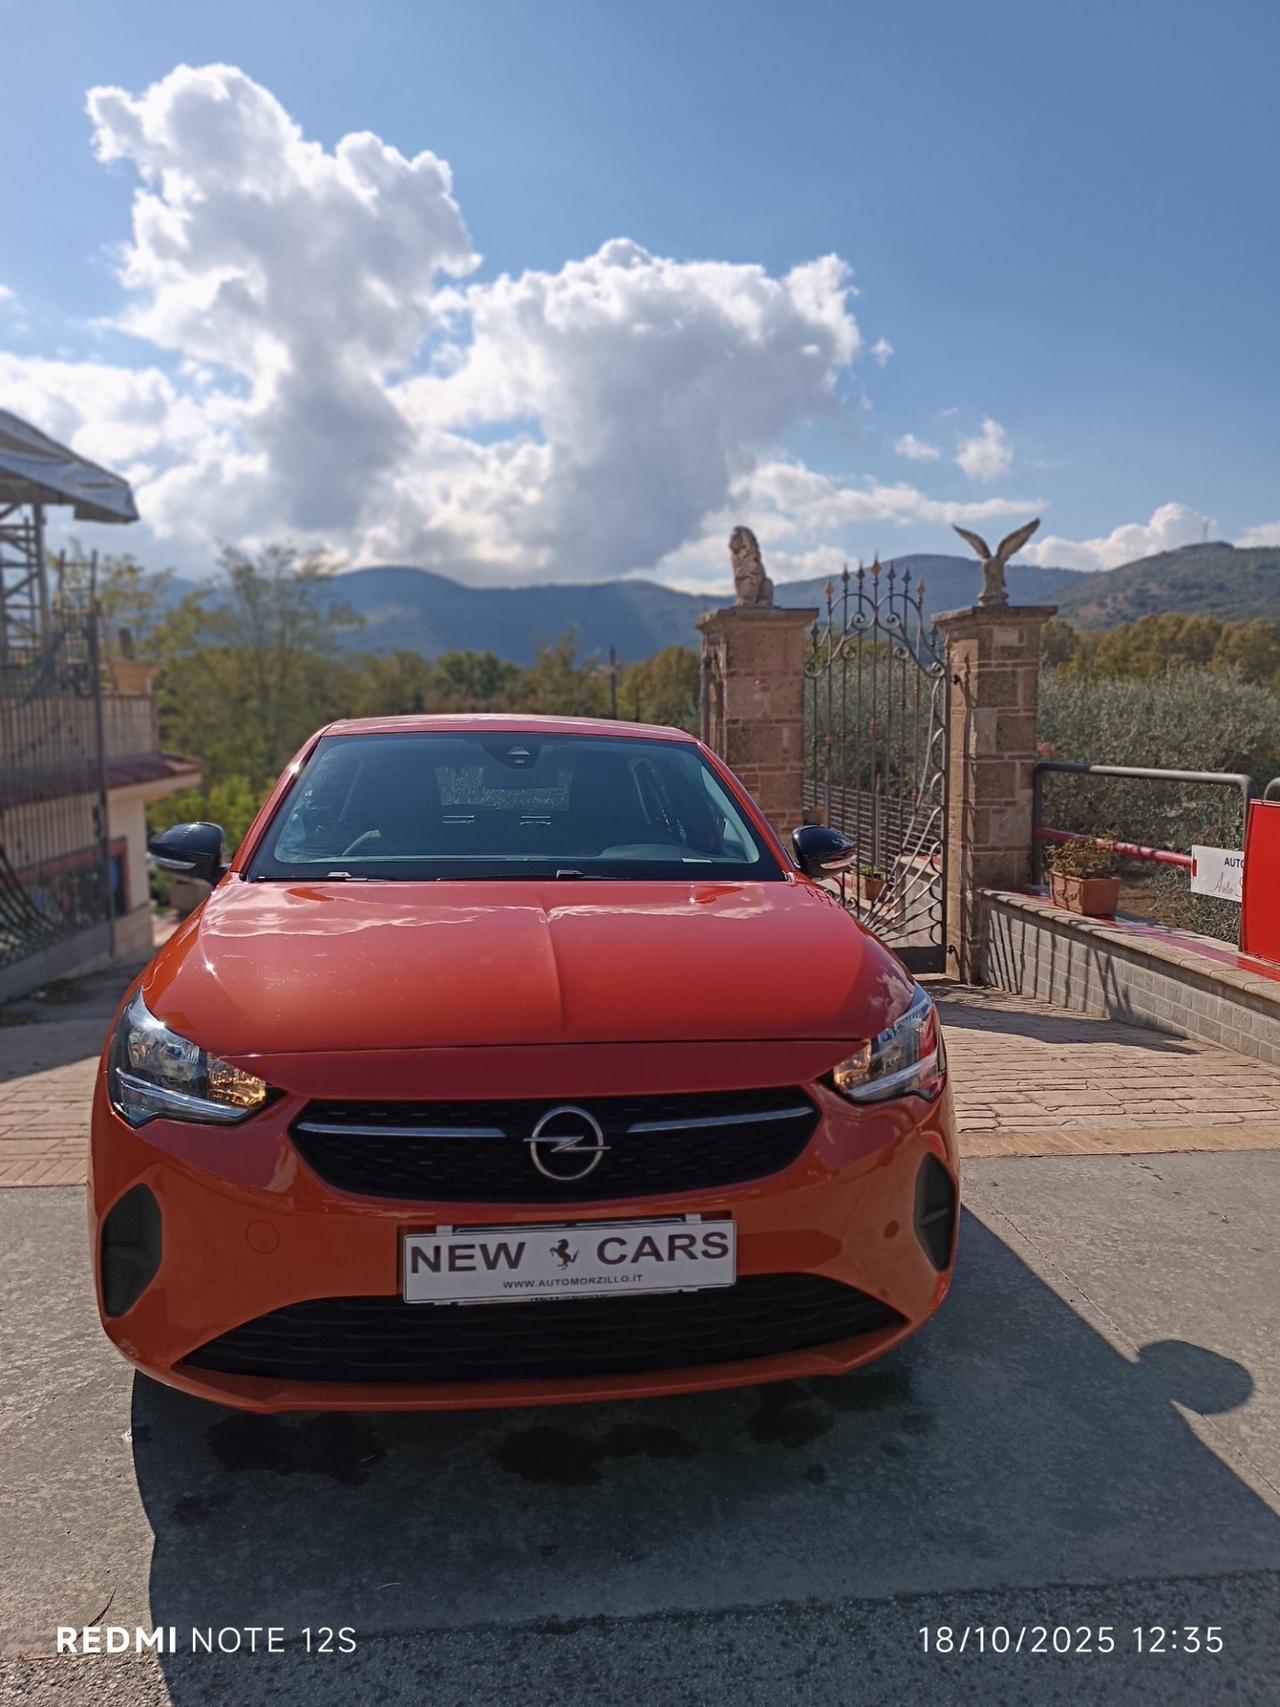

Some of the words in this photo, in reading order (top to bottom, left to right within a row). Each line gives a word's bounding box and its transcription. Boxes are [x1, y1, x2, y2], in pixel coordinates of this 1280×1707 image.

[410, 1241, 526, 1274] NEW
[596, 1231, 729, 1265] CARS
[503, 1274, 644, 1289] WWW.AUTOMORZILLO.IT
